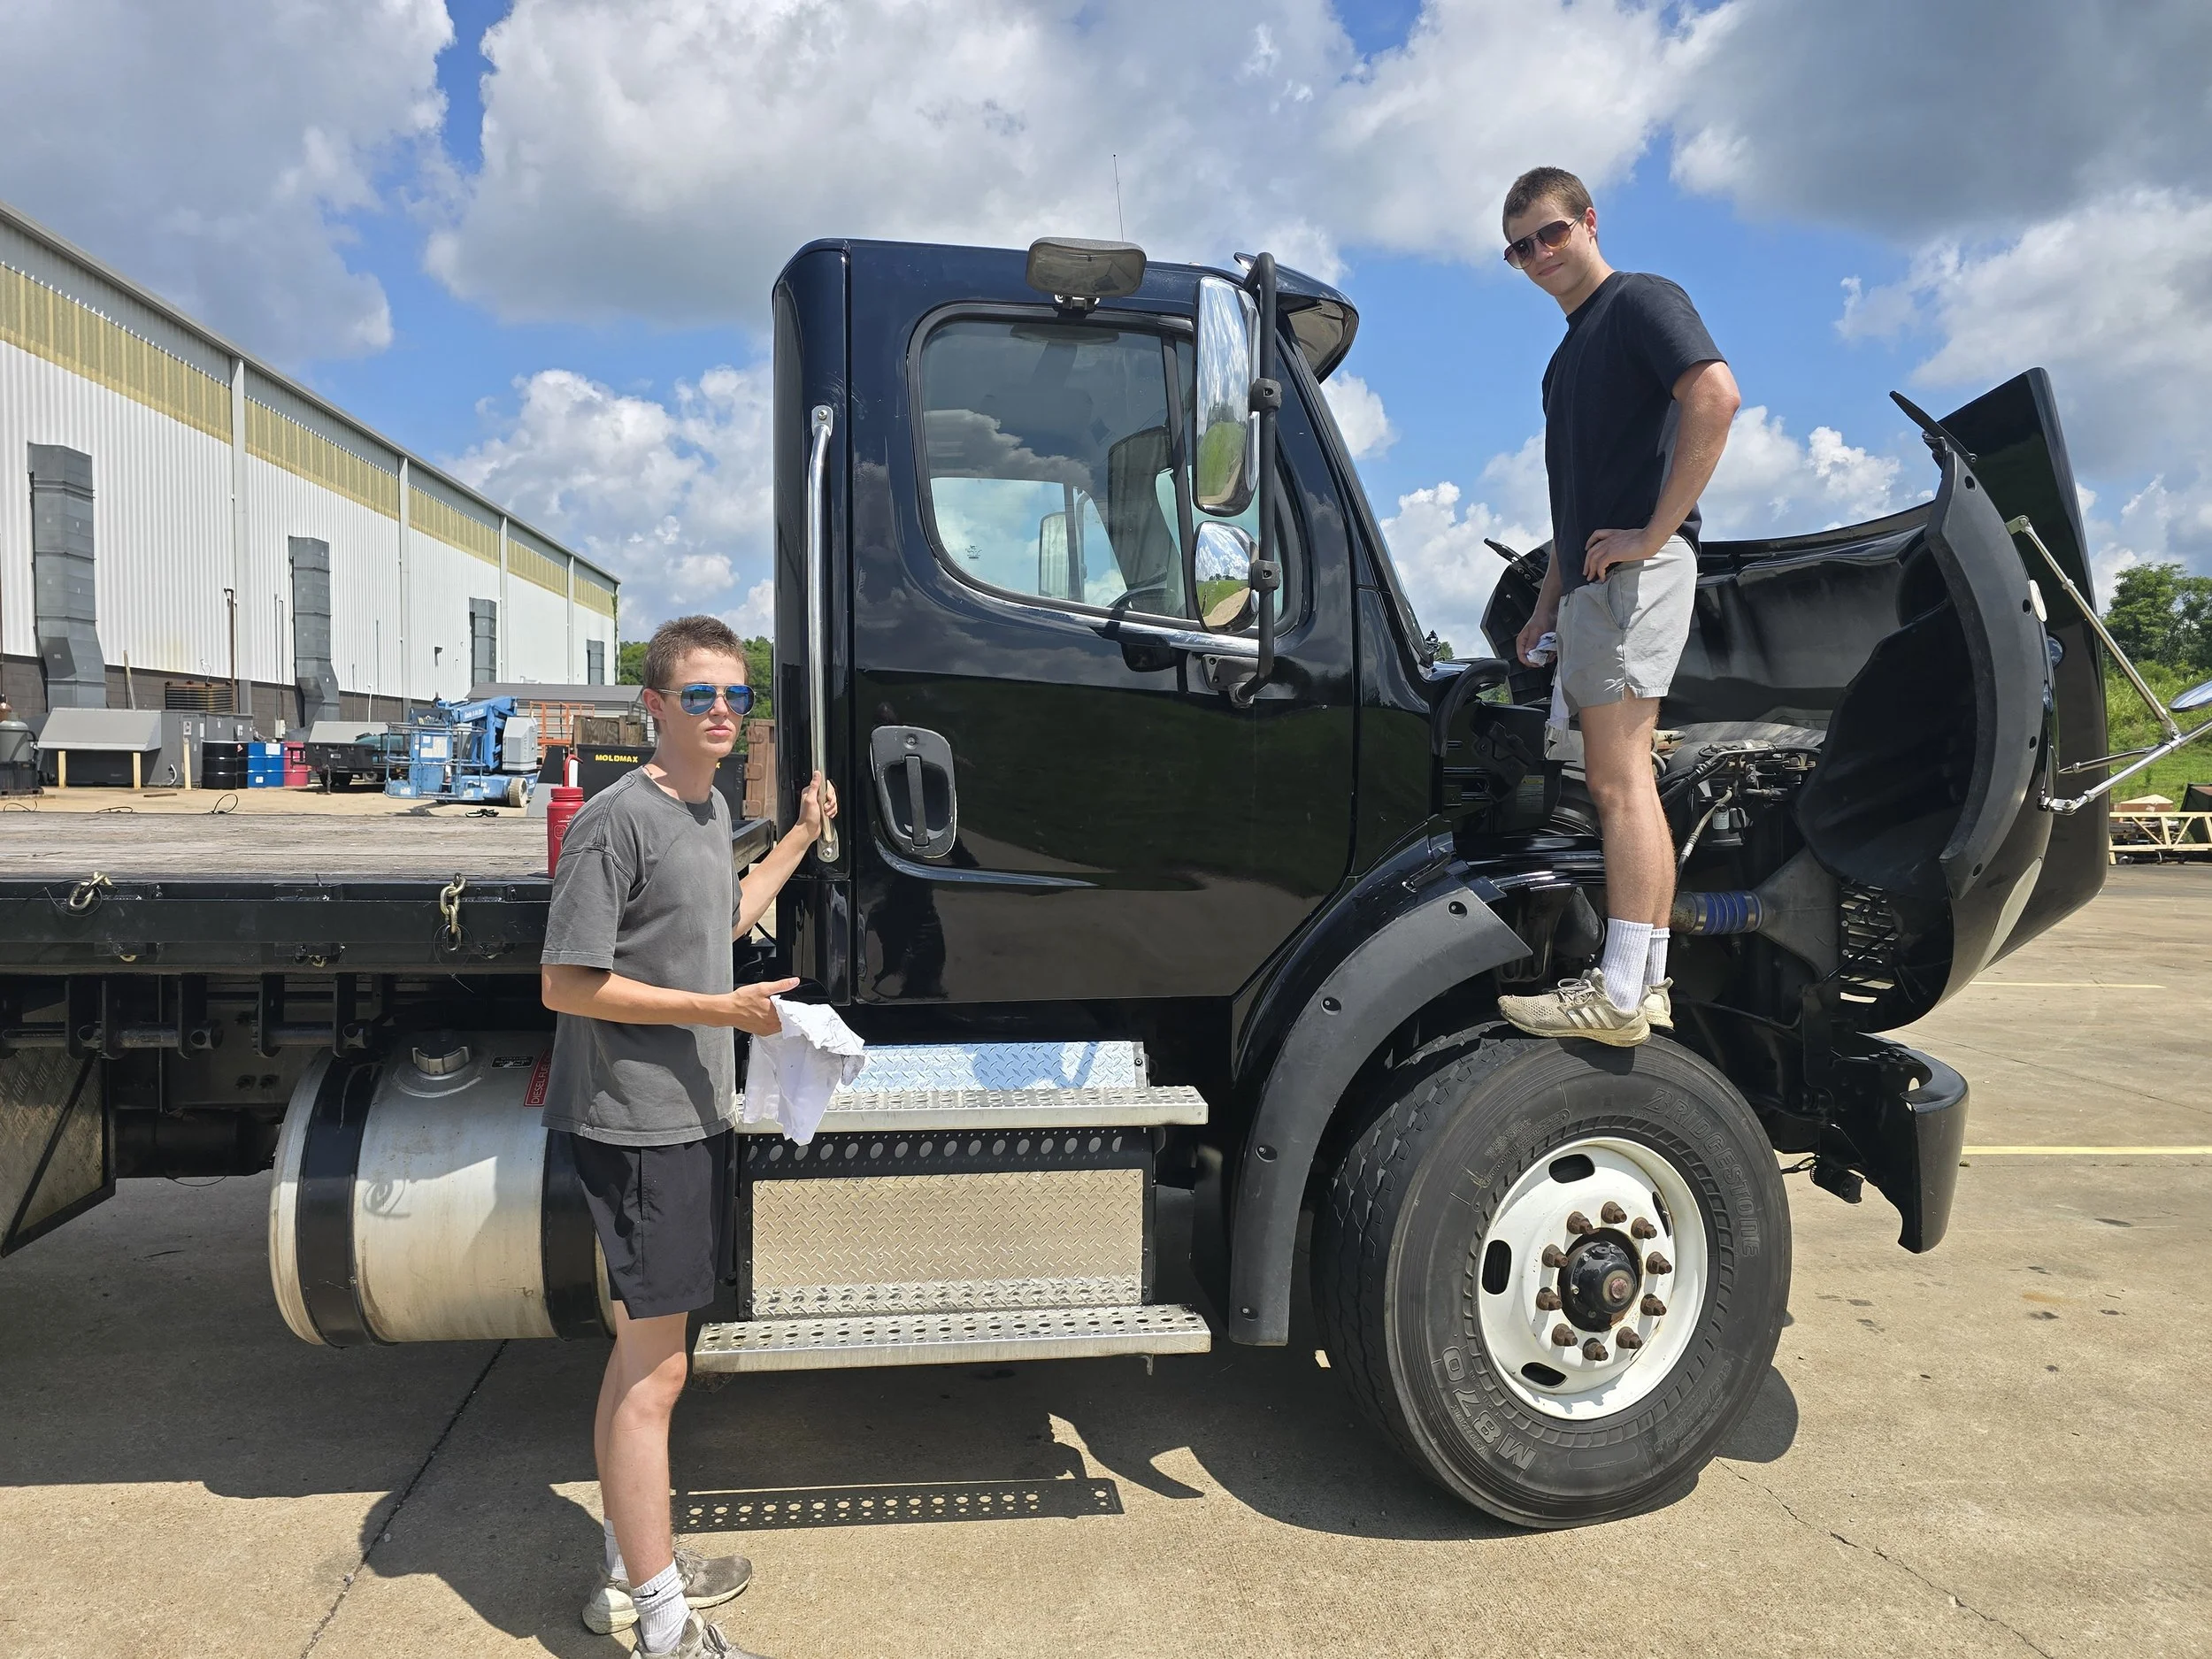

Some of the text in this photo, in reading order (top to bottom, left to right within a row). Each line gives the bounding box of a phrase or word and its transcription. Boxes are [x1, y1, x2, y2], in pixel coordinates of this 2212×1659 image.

[595, 754, 638, 764] MOLDMAX
[531, 1077, 546, 1104] DIESEL
[1643, 1087, 1761, 1257] BRIDGESTONE
[1441, 1346, 1538, 1471] M870
